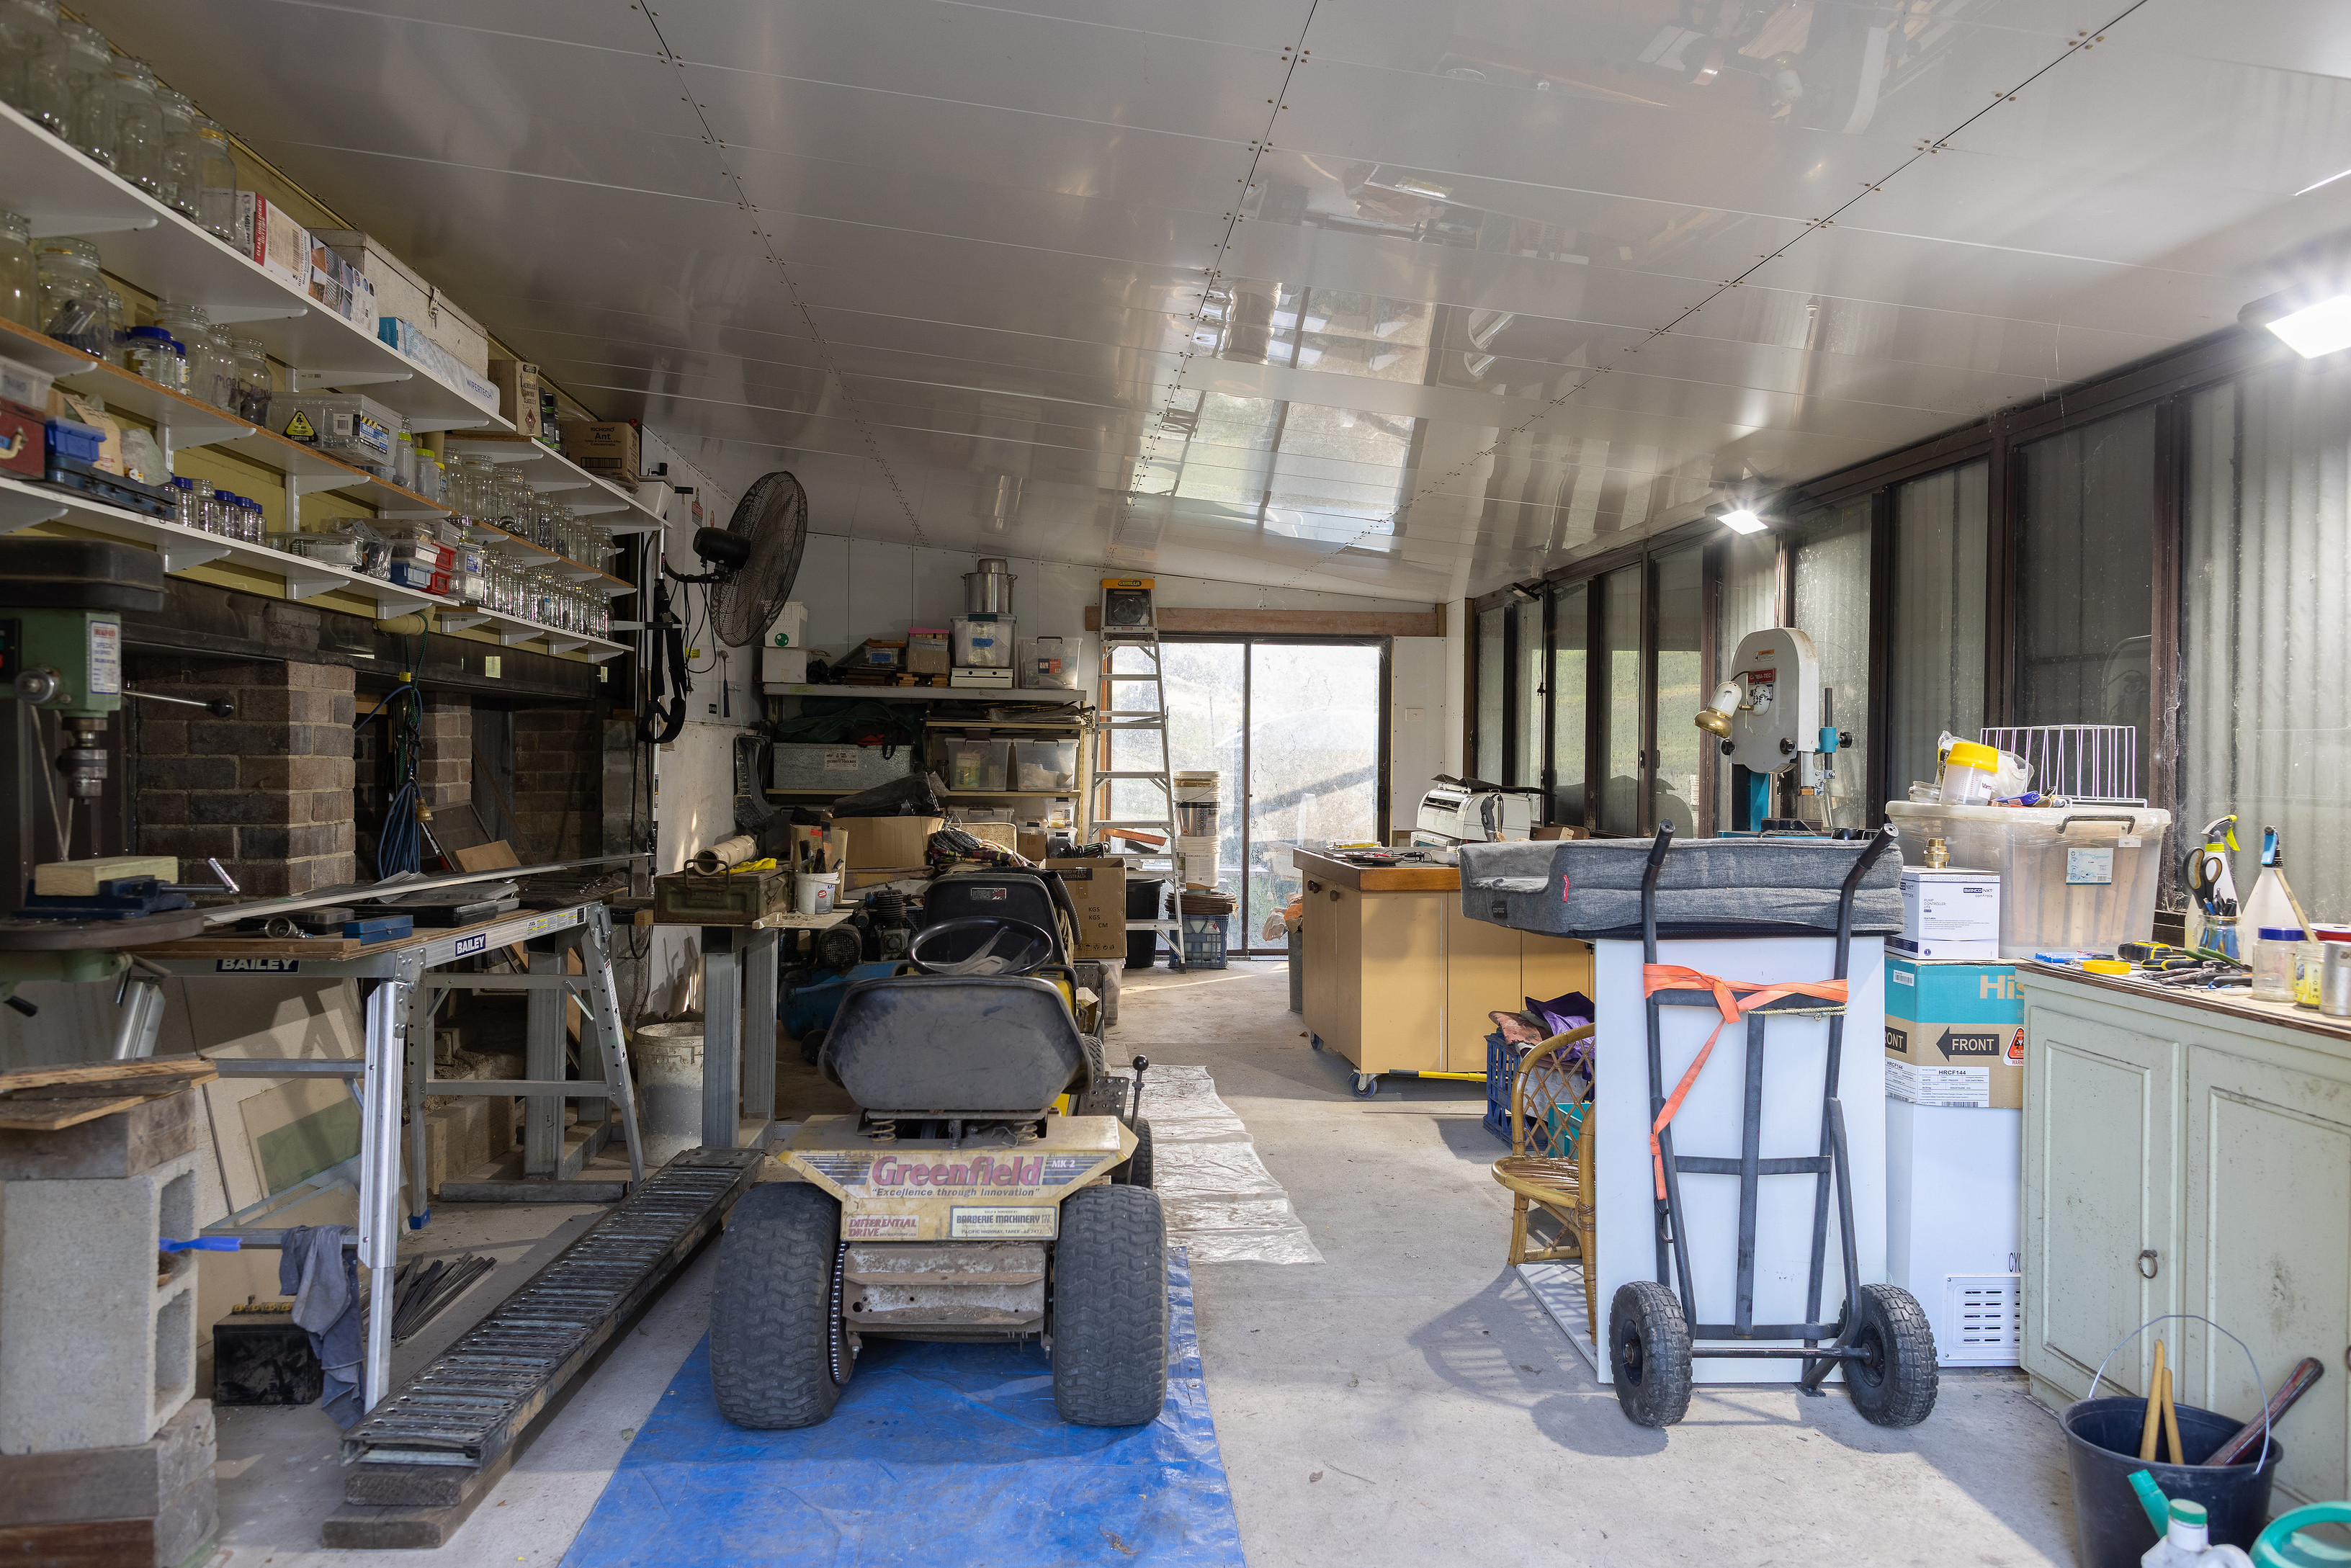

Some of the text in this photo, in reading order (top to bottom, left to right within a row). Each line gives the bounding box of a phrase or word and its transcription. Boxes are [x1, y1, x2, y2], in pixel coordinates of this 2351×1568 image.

[466, 377, 491, 399] WIPERTECH
[457, 936, 485, 954] BAILEY
[221, 959, 295, 970] BAILEY
[1951, 1039, 1994, 1051] FRONT
[872, 1156, 1044, 1186] Greenfield
[872, 1188, 1040, 1198] “Excellence through Innovation”
[848, 1219, 917, 1228] DIFFERENTIAL
[957, 1215, 993, 1224] BARBERIE
[995, 1215, 1040, 1224] MACHINERY
[848, 1228, 879, 1237] DRIVE
